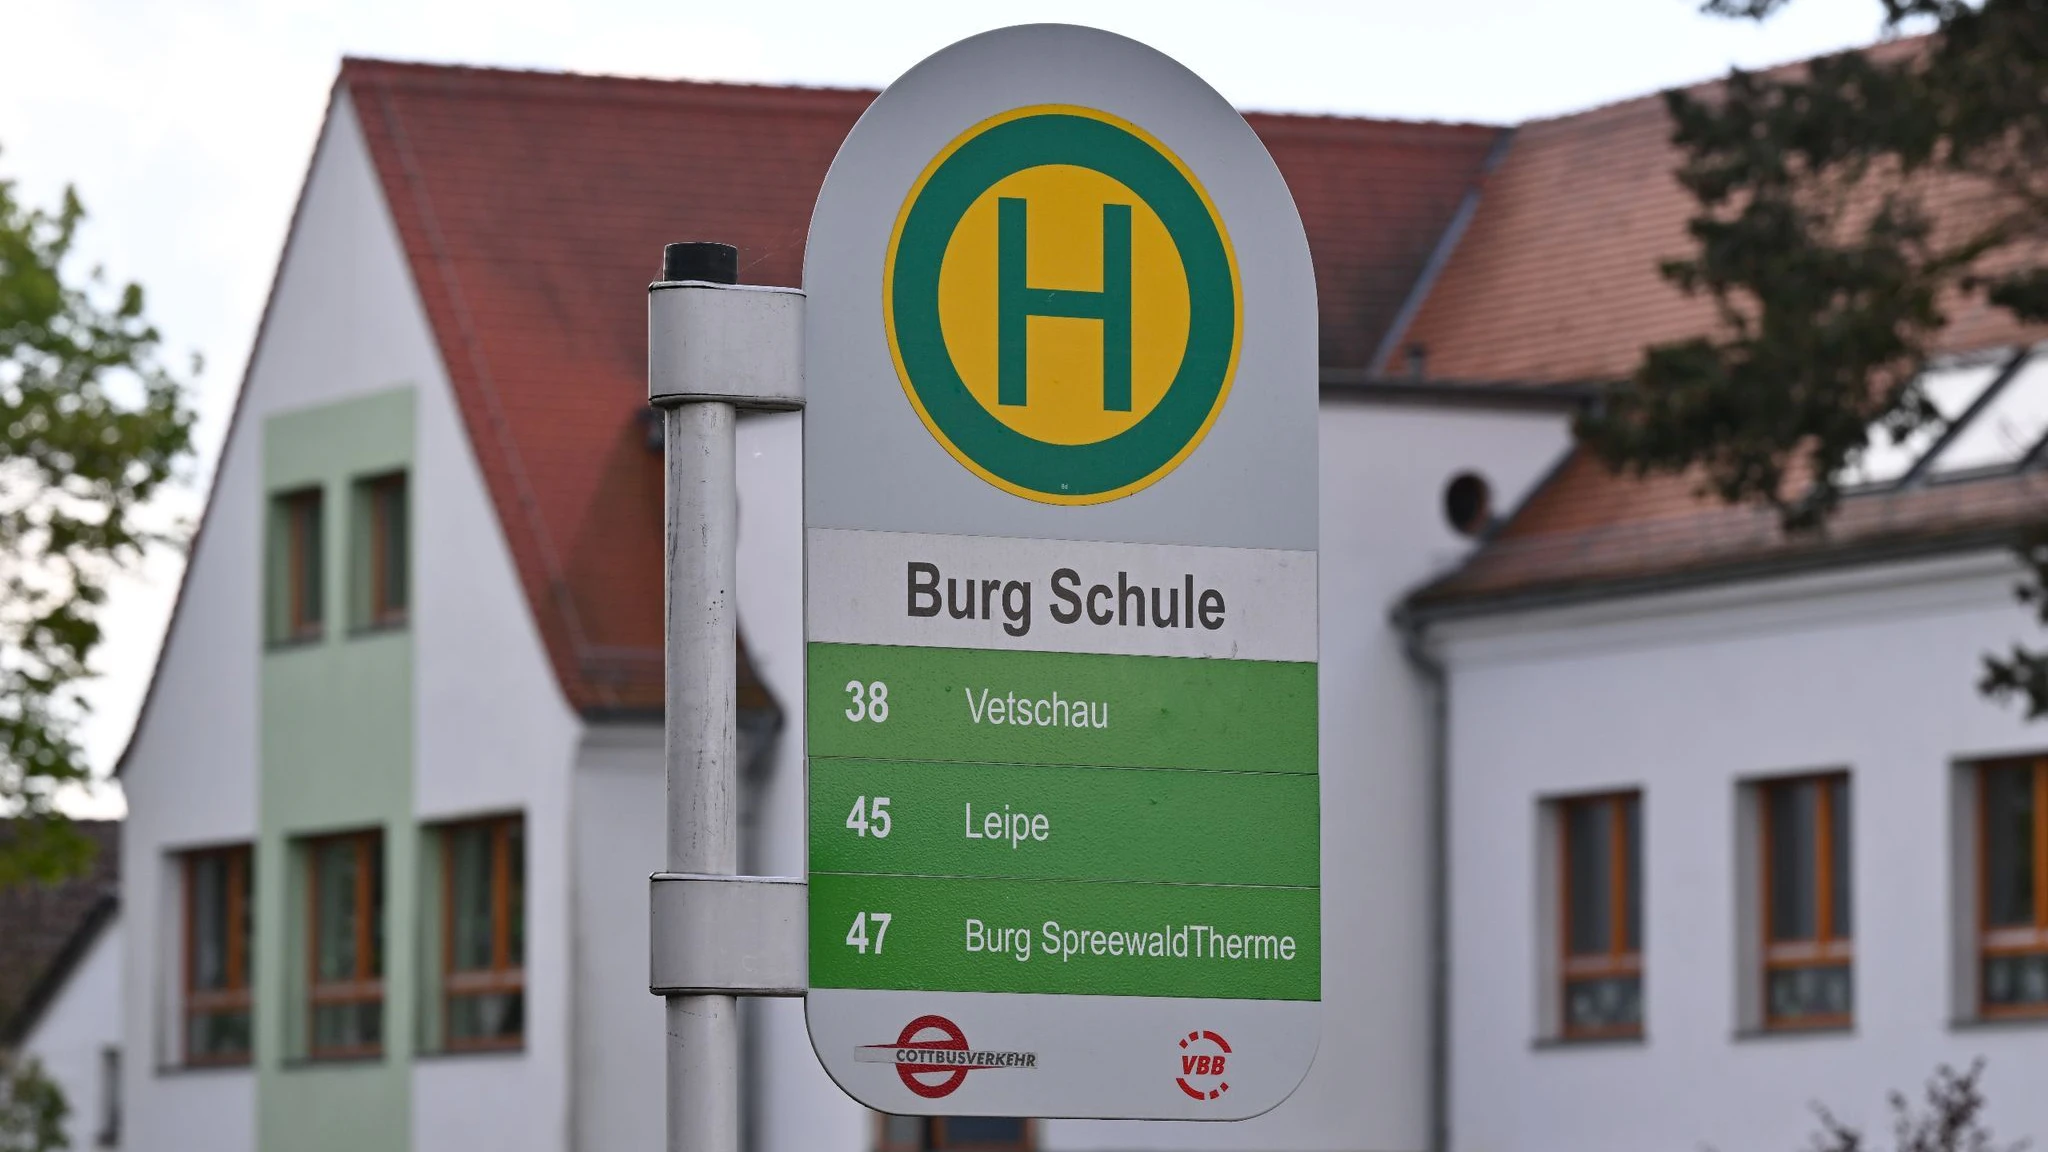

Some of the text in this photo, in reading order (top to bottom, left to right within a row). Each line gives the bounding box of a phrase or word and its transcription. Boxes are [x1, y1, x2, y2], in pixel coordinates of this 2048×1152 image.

[998, 197, 1131, 412] H
[907, 561, 1226, 637] Burg Schule
[844, 680, 1109, 728] 38 Vetschau
[845, 796, 1050, 849] 45 Leipe
[845, 912, 1297, 961] 47 Burg SpreewaldTherme
[896, 1048, 1037, 1068] COTTBUSVERKEHR
[1181, 1055, 1226, 1076] VBB
